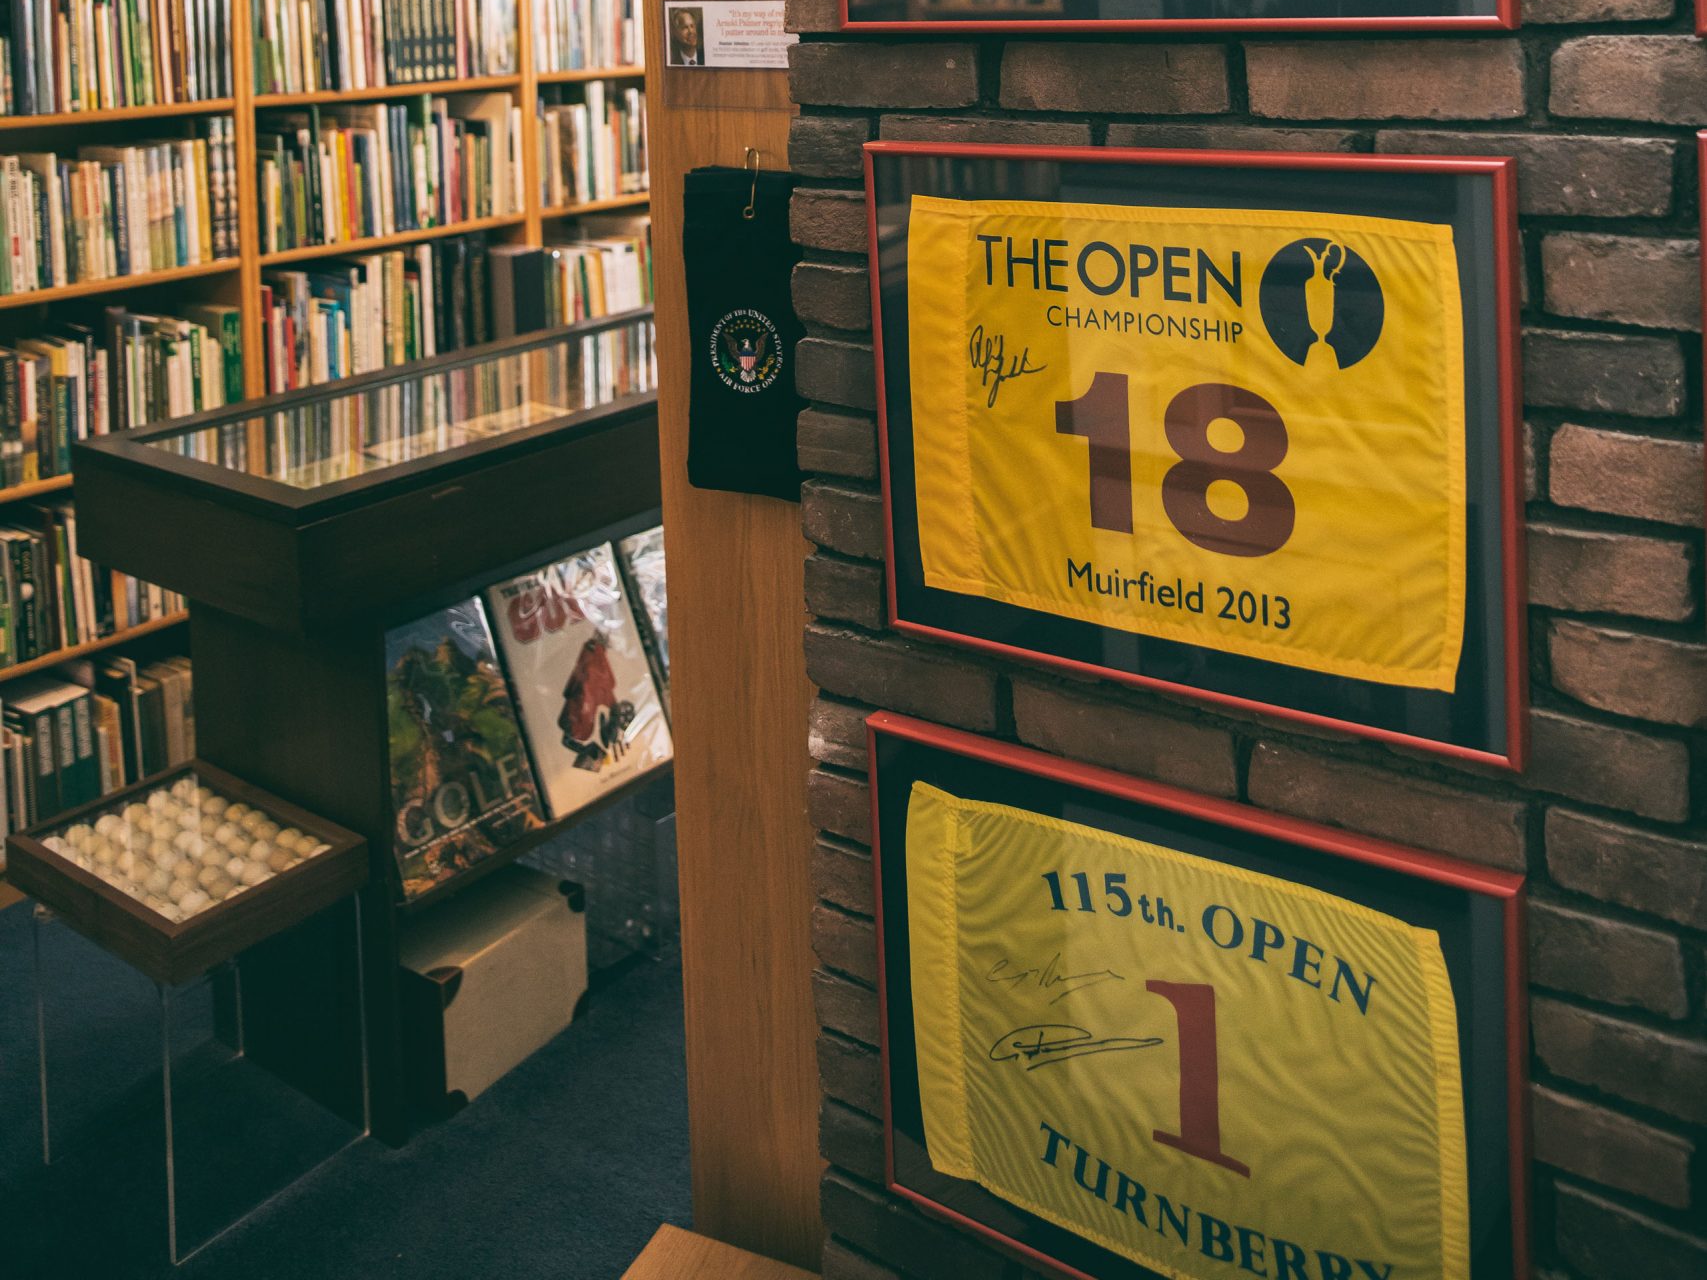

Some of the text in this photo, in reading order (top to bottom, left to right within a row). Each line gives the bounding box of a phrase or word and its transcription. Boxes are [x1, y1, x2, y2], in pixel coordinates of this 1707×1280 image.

[976, 234, 1243, 308] THE OPEN
[748, 308, 776, 332] UNITED
[1046, 305, 1244, 344] CHAMPIONSHIP
[718, 372, 778, 394] AIR FORCE ONE
[1054, 370, 1296, 558] 18
[1066, 557, 1292, 630] Muirfield 2013
[397, 753, 519, 846] GOLF
[1041, 870, 1186, 934] 115th.
[1201, 904, 1378, 1017] OPEN
[1144, 979, 1251, 1179] 1
[1038, 1121, 1395, 1280] TURNBERRY
